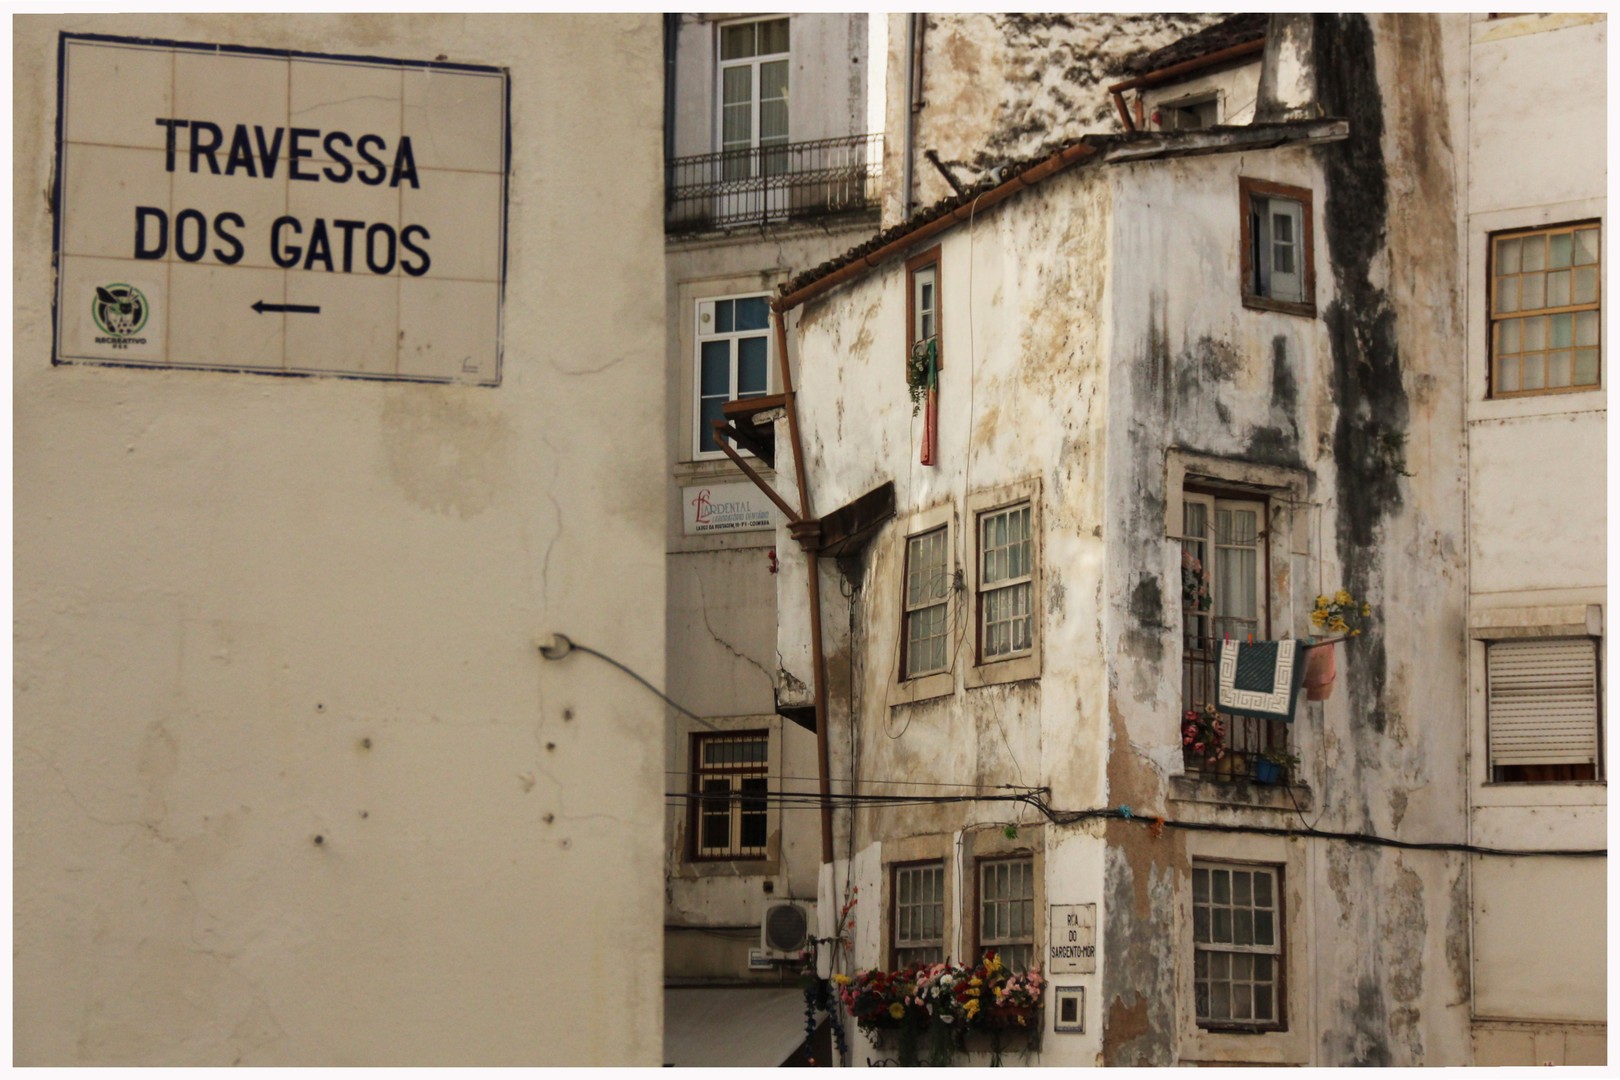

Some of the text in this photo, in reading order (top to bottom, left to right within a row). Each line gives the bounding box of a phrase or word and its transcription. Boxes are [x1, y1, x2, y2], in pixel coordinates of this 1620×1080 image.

[156, 118, 420, 189] TRAVESSA
[134, 206, 431, 277] DOS GATOS
[1051, 946, 1095, 958] SARGENTO-MOR
[1068, 930, 1077, 942] DO
